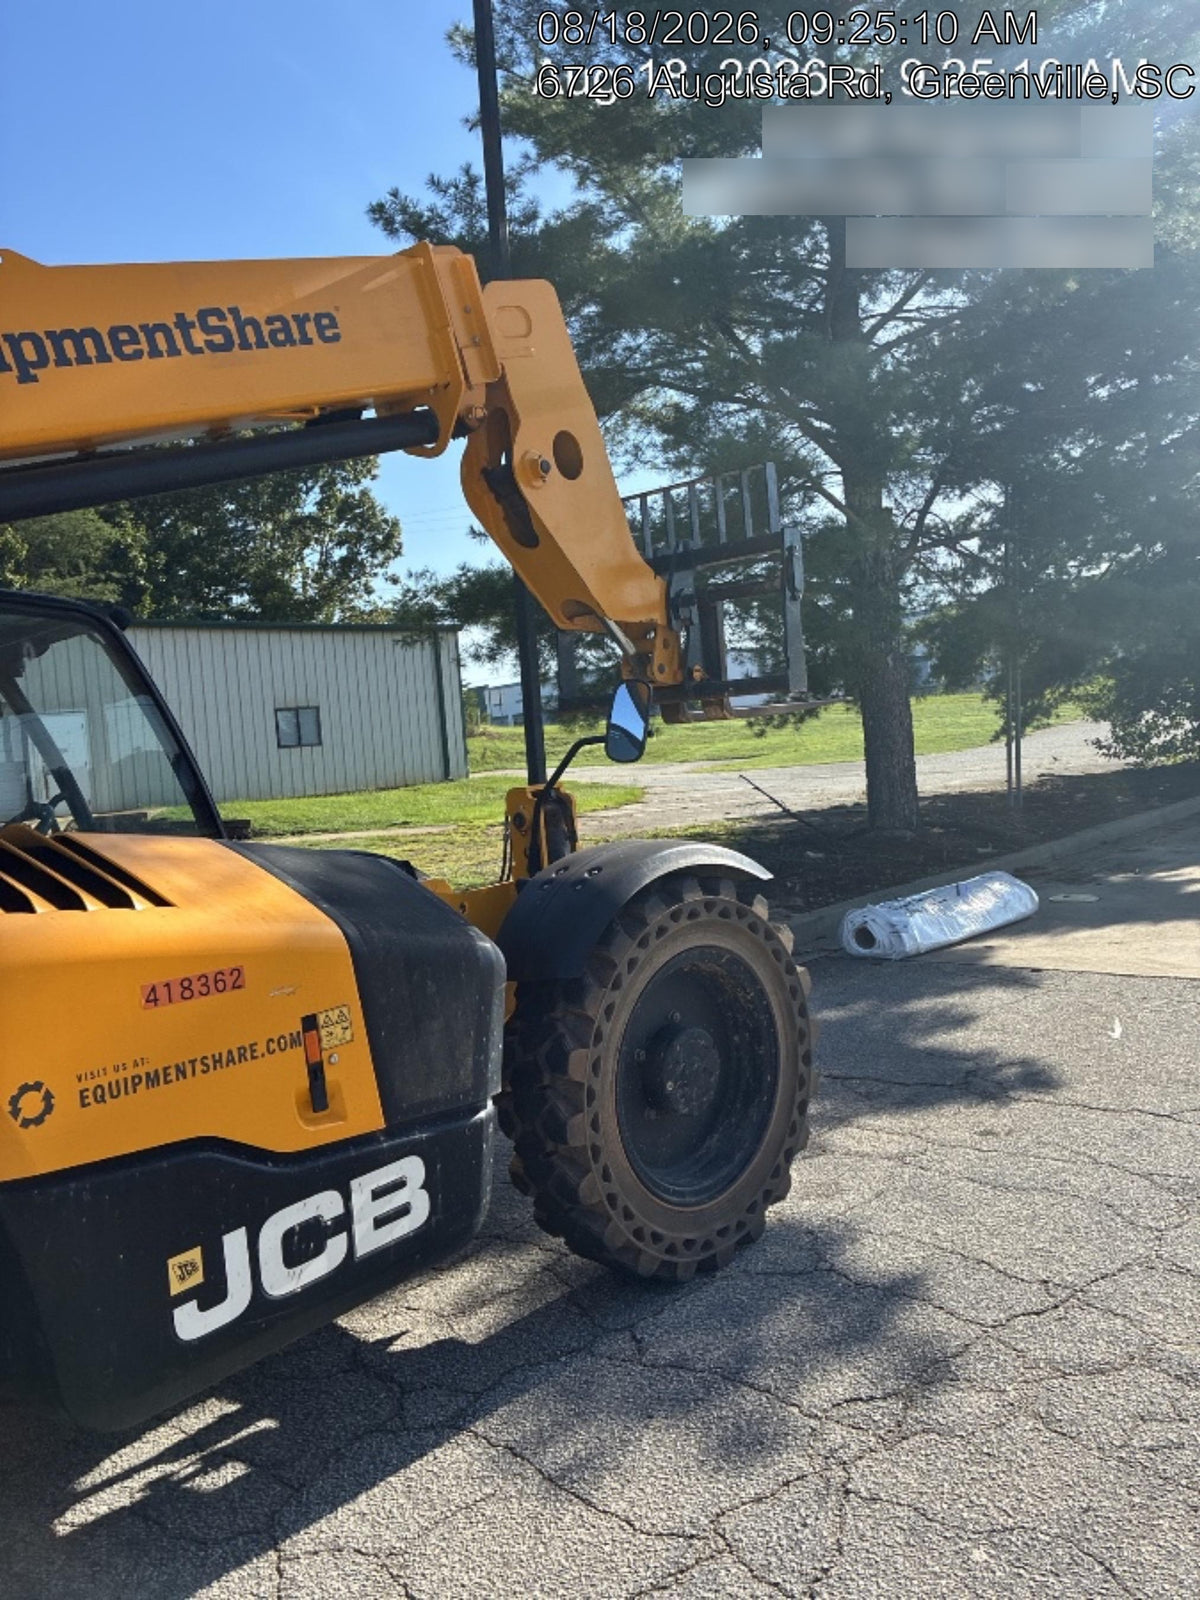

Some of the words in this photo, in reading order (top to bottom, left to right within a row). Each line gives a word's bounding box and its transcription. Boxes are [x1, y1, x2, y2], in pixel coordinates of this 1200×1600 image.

[145, 968, 242, 1007] 418362
[76, 1066, 108, 1083] VISIT
[113, 1062, 128, 1073] US
[132, 1057, 150, 1069] AT:
[79, 1030, 303, 1109] EQUIPMENTSHARE.COM
[172, 1155, 430, 1341] JCB
